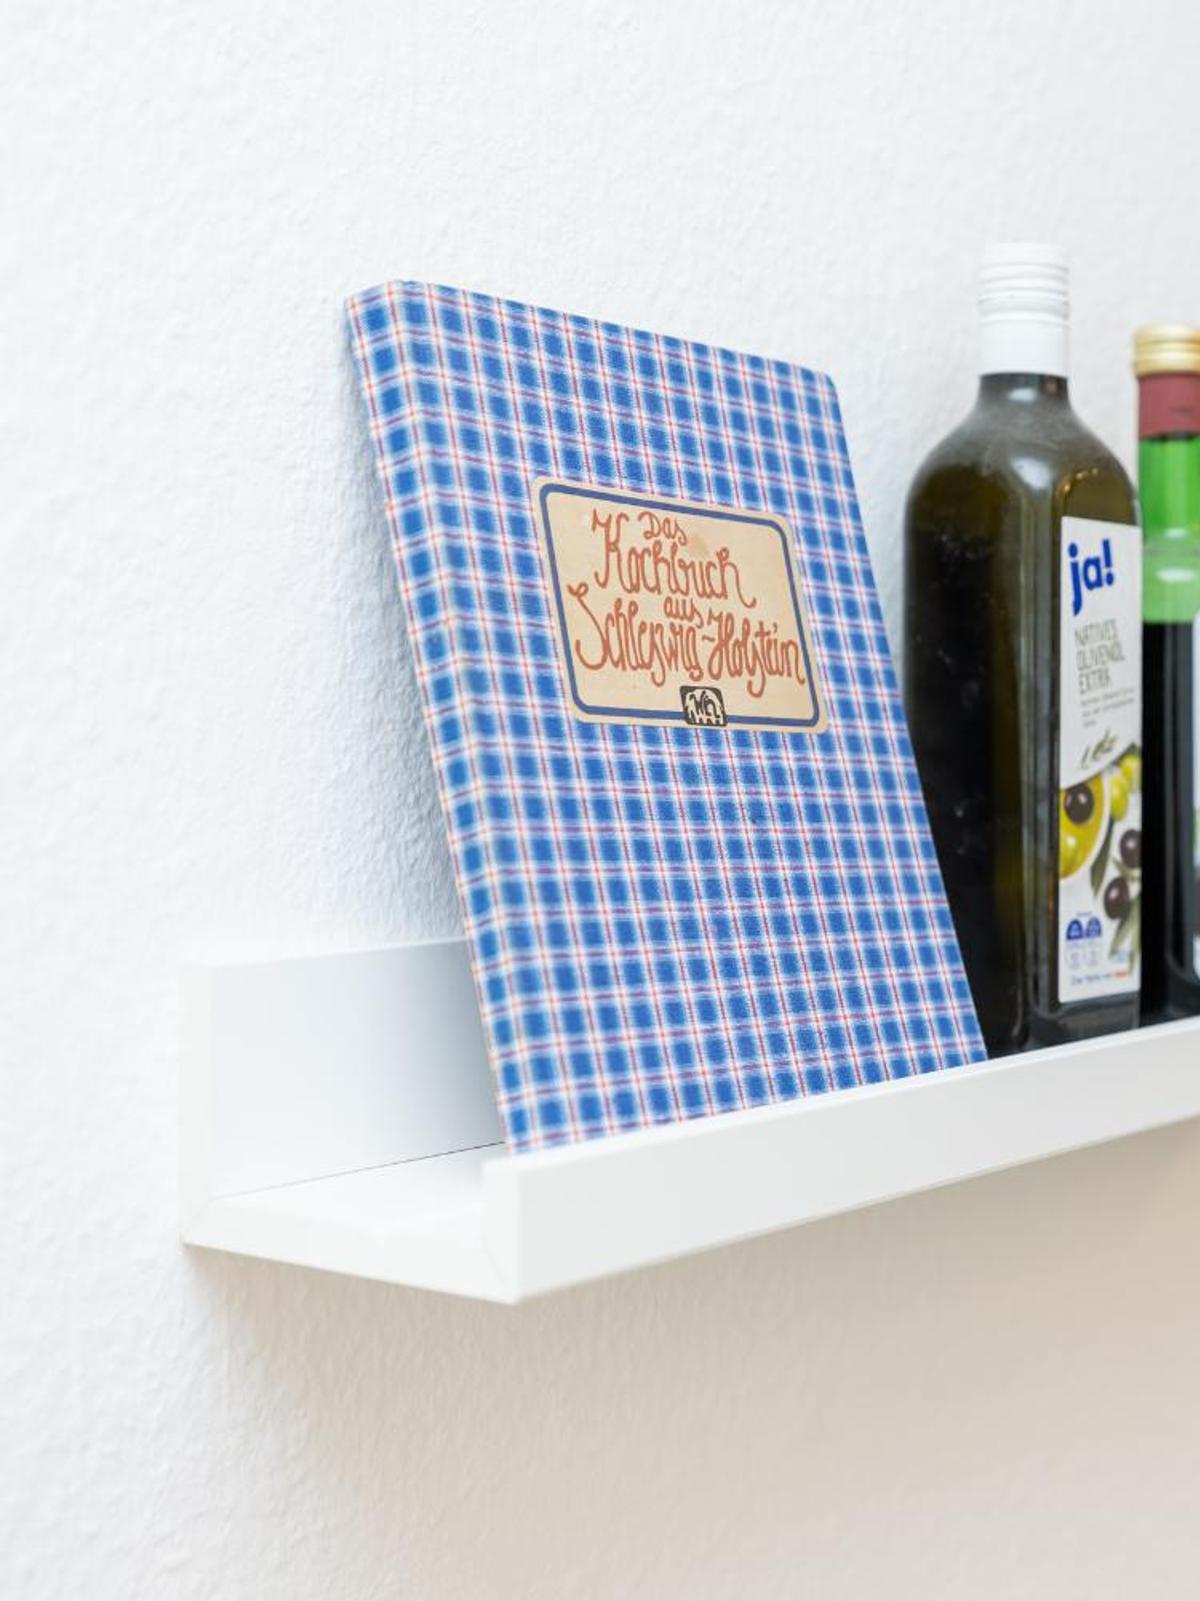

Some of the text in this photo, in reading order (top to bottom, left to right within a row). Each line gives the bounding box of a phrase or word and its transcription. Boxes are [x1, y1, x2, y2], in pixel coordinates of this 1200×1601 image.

[637, 511, 687, 546] Das
[591, 508, 757, 608] Kochbuch
[1067, 538, 1115, 617] ja!
[664, 596, 704, 629] aus
[1079, 668, 1112, 695] EXTRA
